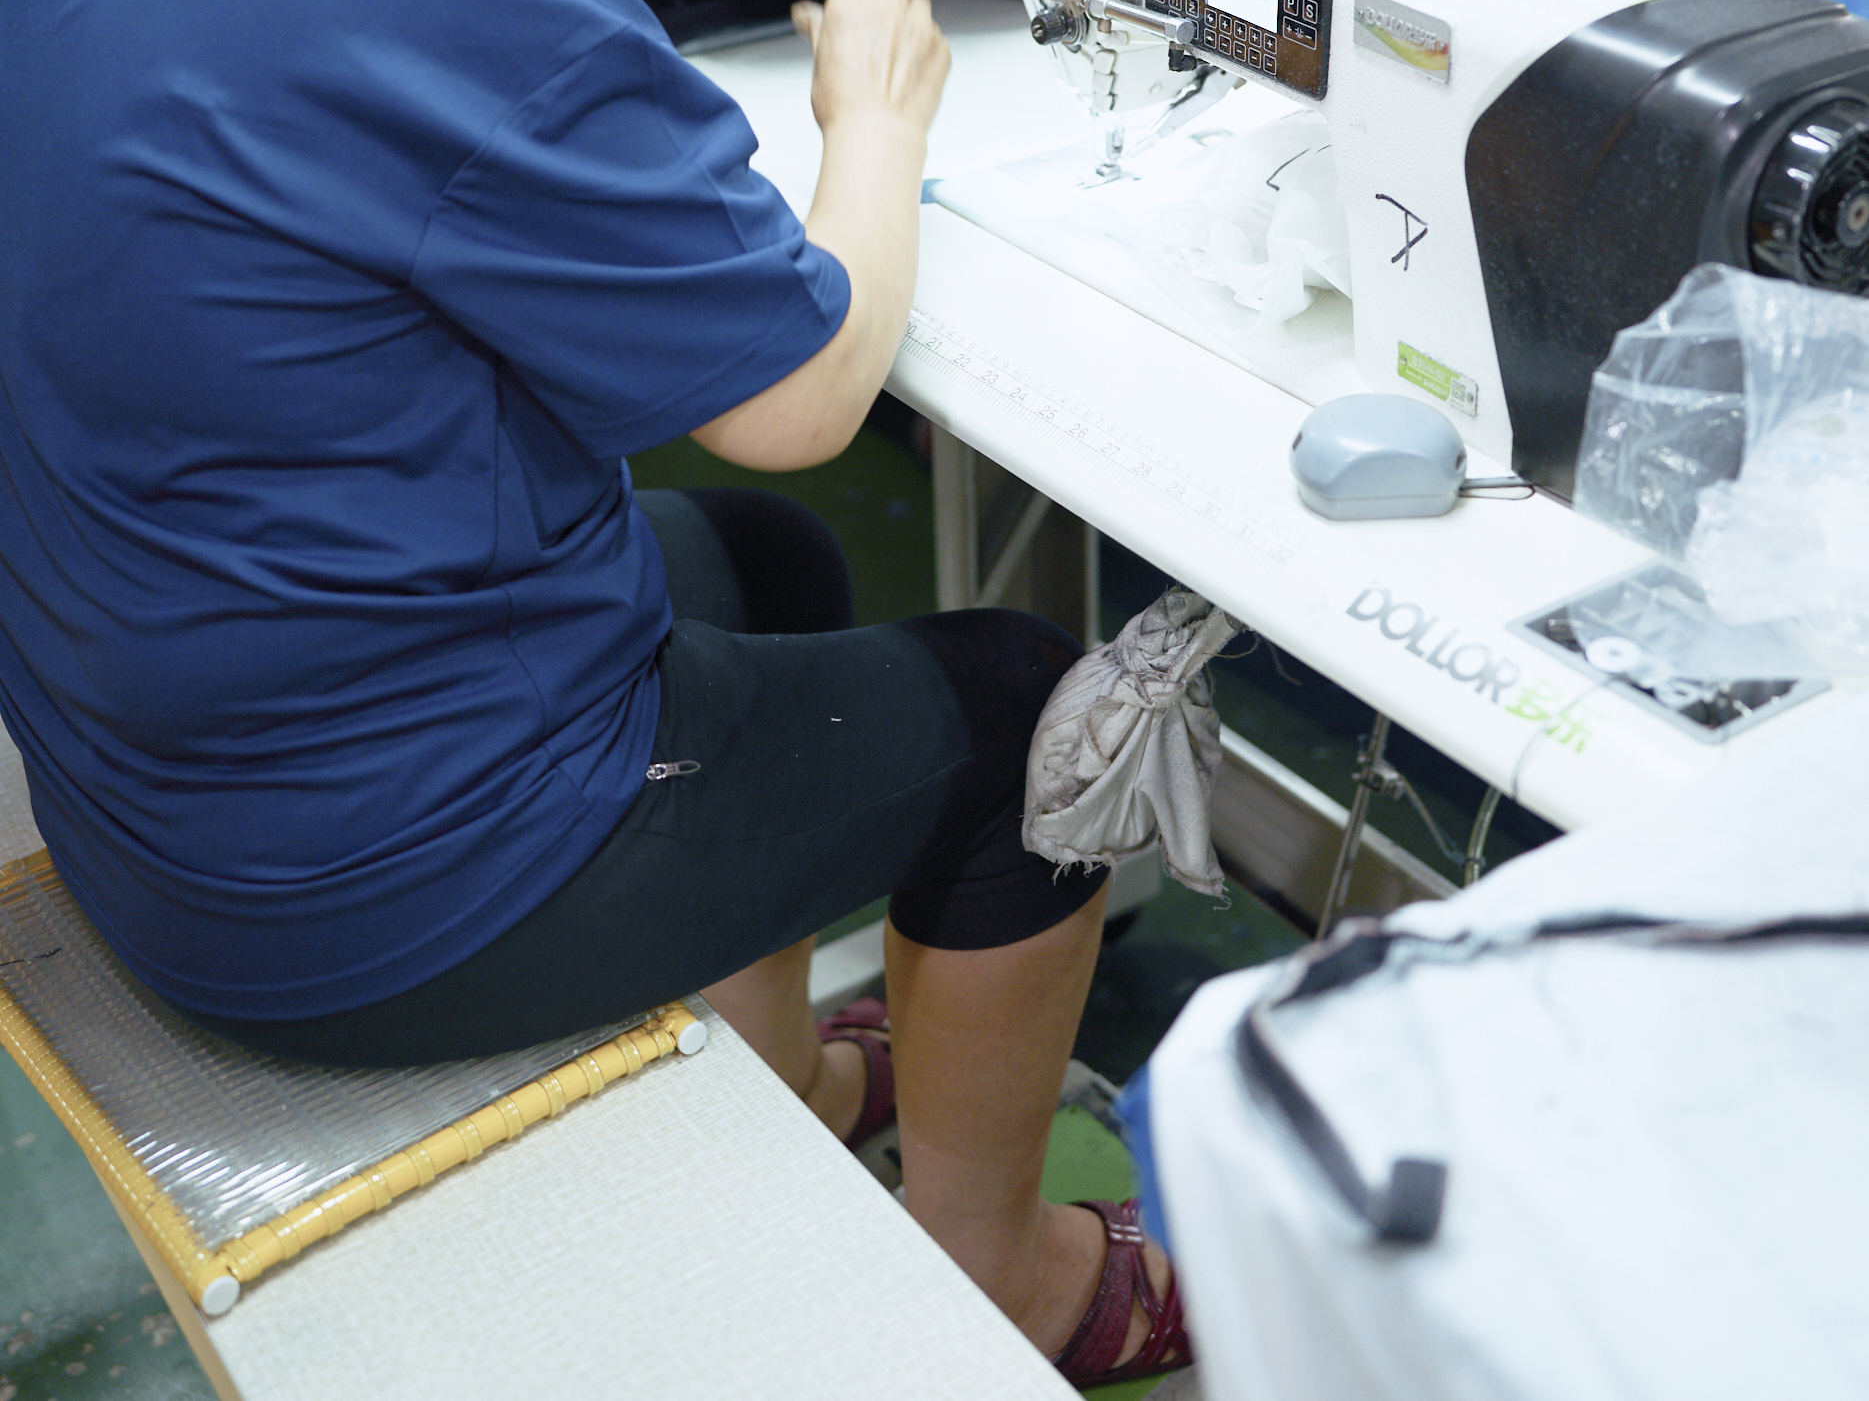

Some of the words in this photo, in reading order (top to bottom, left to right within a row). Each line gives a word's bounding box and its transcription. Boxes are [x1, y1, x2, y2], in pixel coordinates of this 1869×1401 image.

[1305, 3, 1315, 18] S
[925, 336, 944, 351] 21
[953, 353, 972, 368] 22
[980, 370, 999, 385] 23
[1009, 387, 1029, 401] 24
[1038, 404, 1058, 420] 25
[1069, 423, 1089, 439] 26
[1100, 441, 1121, 457] 27
[1132, 461, 1153, 478] 28
[1165, 481, 1187, 498] 29
[1200, 501, 1221, 520] 30
[1235, 522, 1256, 540] 31
[1345, 589, 1522, 705] DOLLOR
